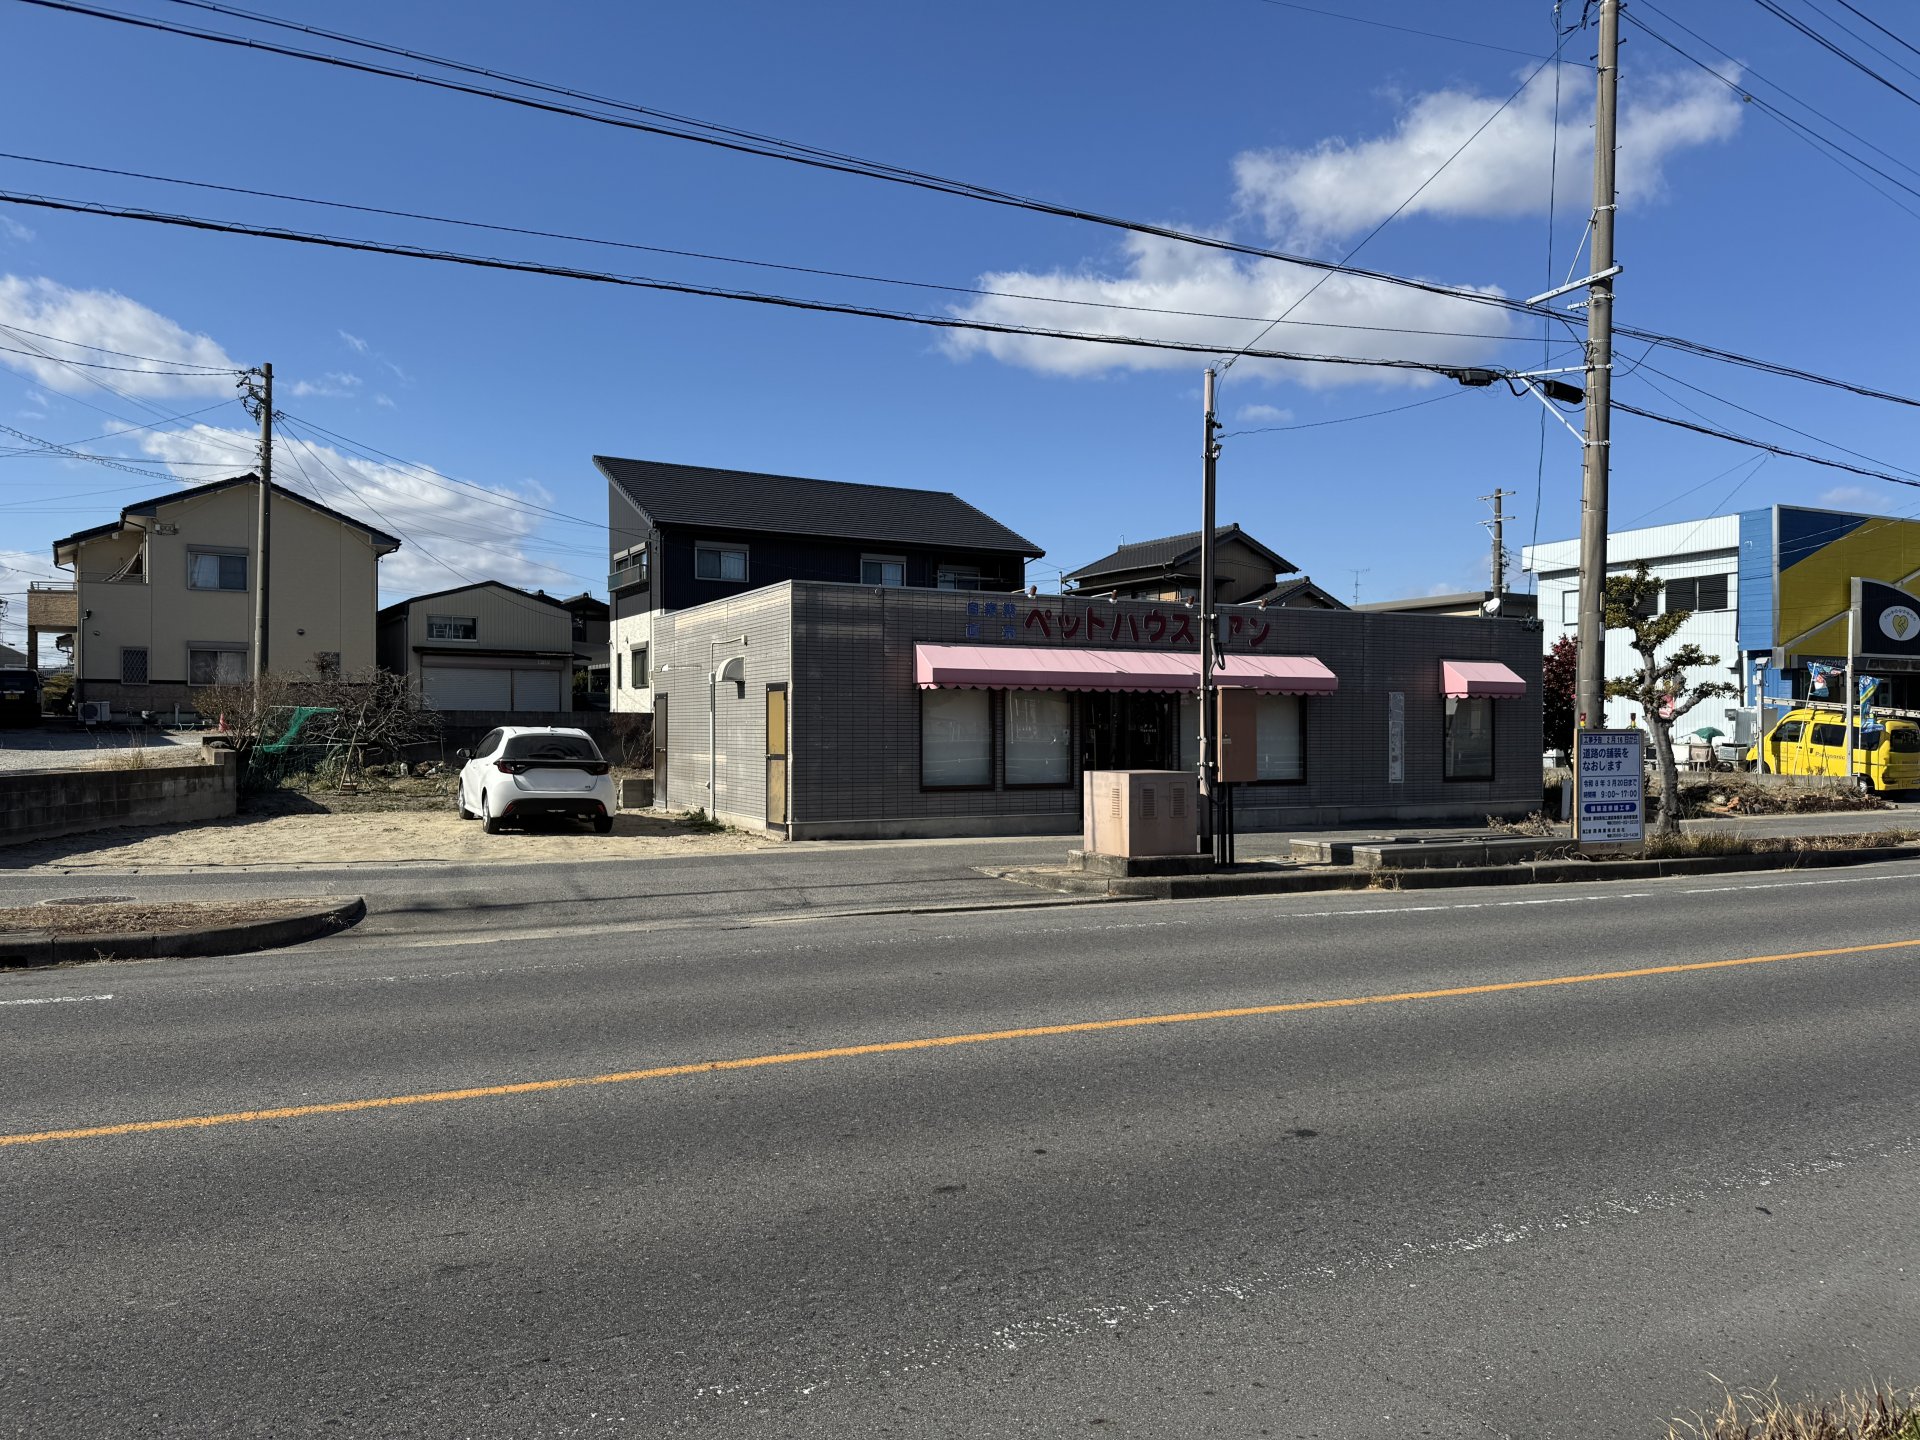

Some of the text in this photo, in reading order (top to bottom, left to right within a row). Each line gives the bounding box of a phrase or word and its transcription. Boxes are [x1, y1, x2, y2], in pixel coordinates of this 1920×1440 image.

[1024, 606, 1194, 645] ペットハウス
[1582, 747, 1629, 759] 道路の舗装を
[1582, 760, 1622, 771] なおします
